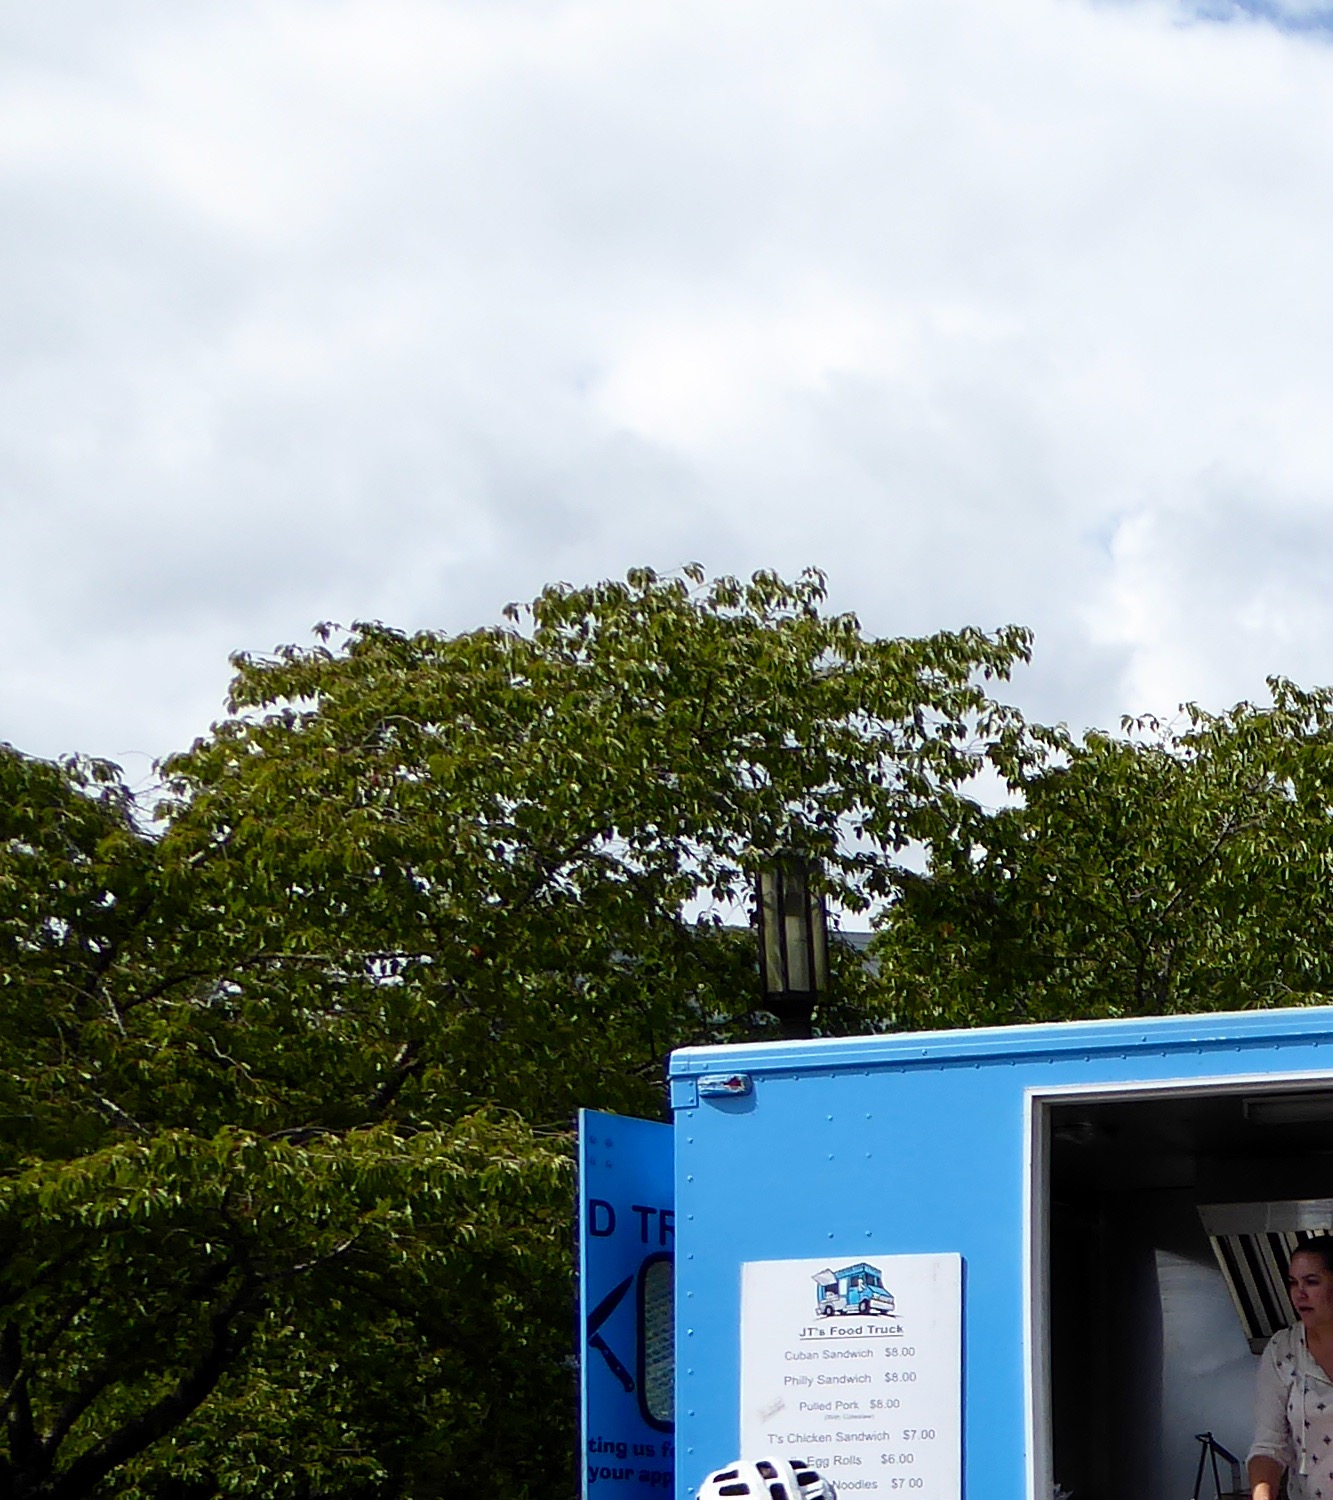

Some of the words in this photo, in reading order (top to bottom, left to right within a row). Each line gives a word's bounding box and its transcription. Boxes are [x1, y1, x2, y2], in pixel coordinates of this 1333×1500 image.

[830, 1325, 863, 1336] Food
[867, 1324, 904, 1335] Truck
[784, 1350, 820, 1361] Cuban
[823, 1348, 874, 1359] Sandwich
[885, 1347, 916, 1357] $8.00
[784, 1375, 814, 1387] Philly
[817, 1373, 872, 1385] Sandwich
[884, 1371, 917, 1383] $8.00
[799, 1401, 832, 1411] Pulled
[835, 1400, 859, 1410] Pork
[869, 1399, 900, 1409] $8.00
[787, 1432, 832, 1444] Chicken
[835, 1431, 890, 1443] Sandwich
[903, 1429, 936, 1440] $7.00
[807, 1455, 830, 1469] Egg
[834, 1454, 862, 1466] Rolls
[881, 1453, 914, 1465] $6.00
[588, 1466, 634, 1484] your
[832, 1479, 878, 1490] Noodles
